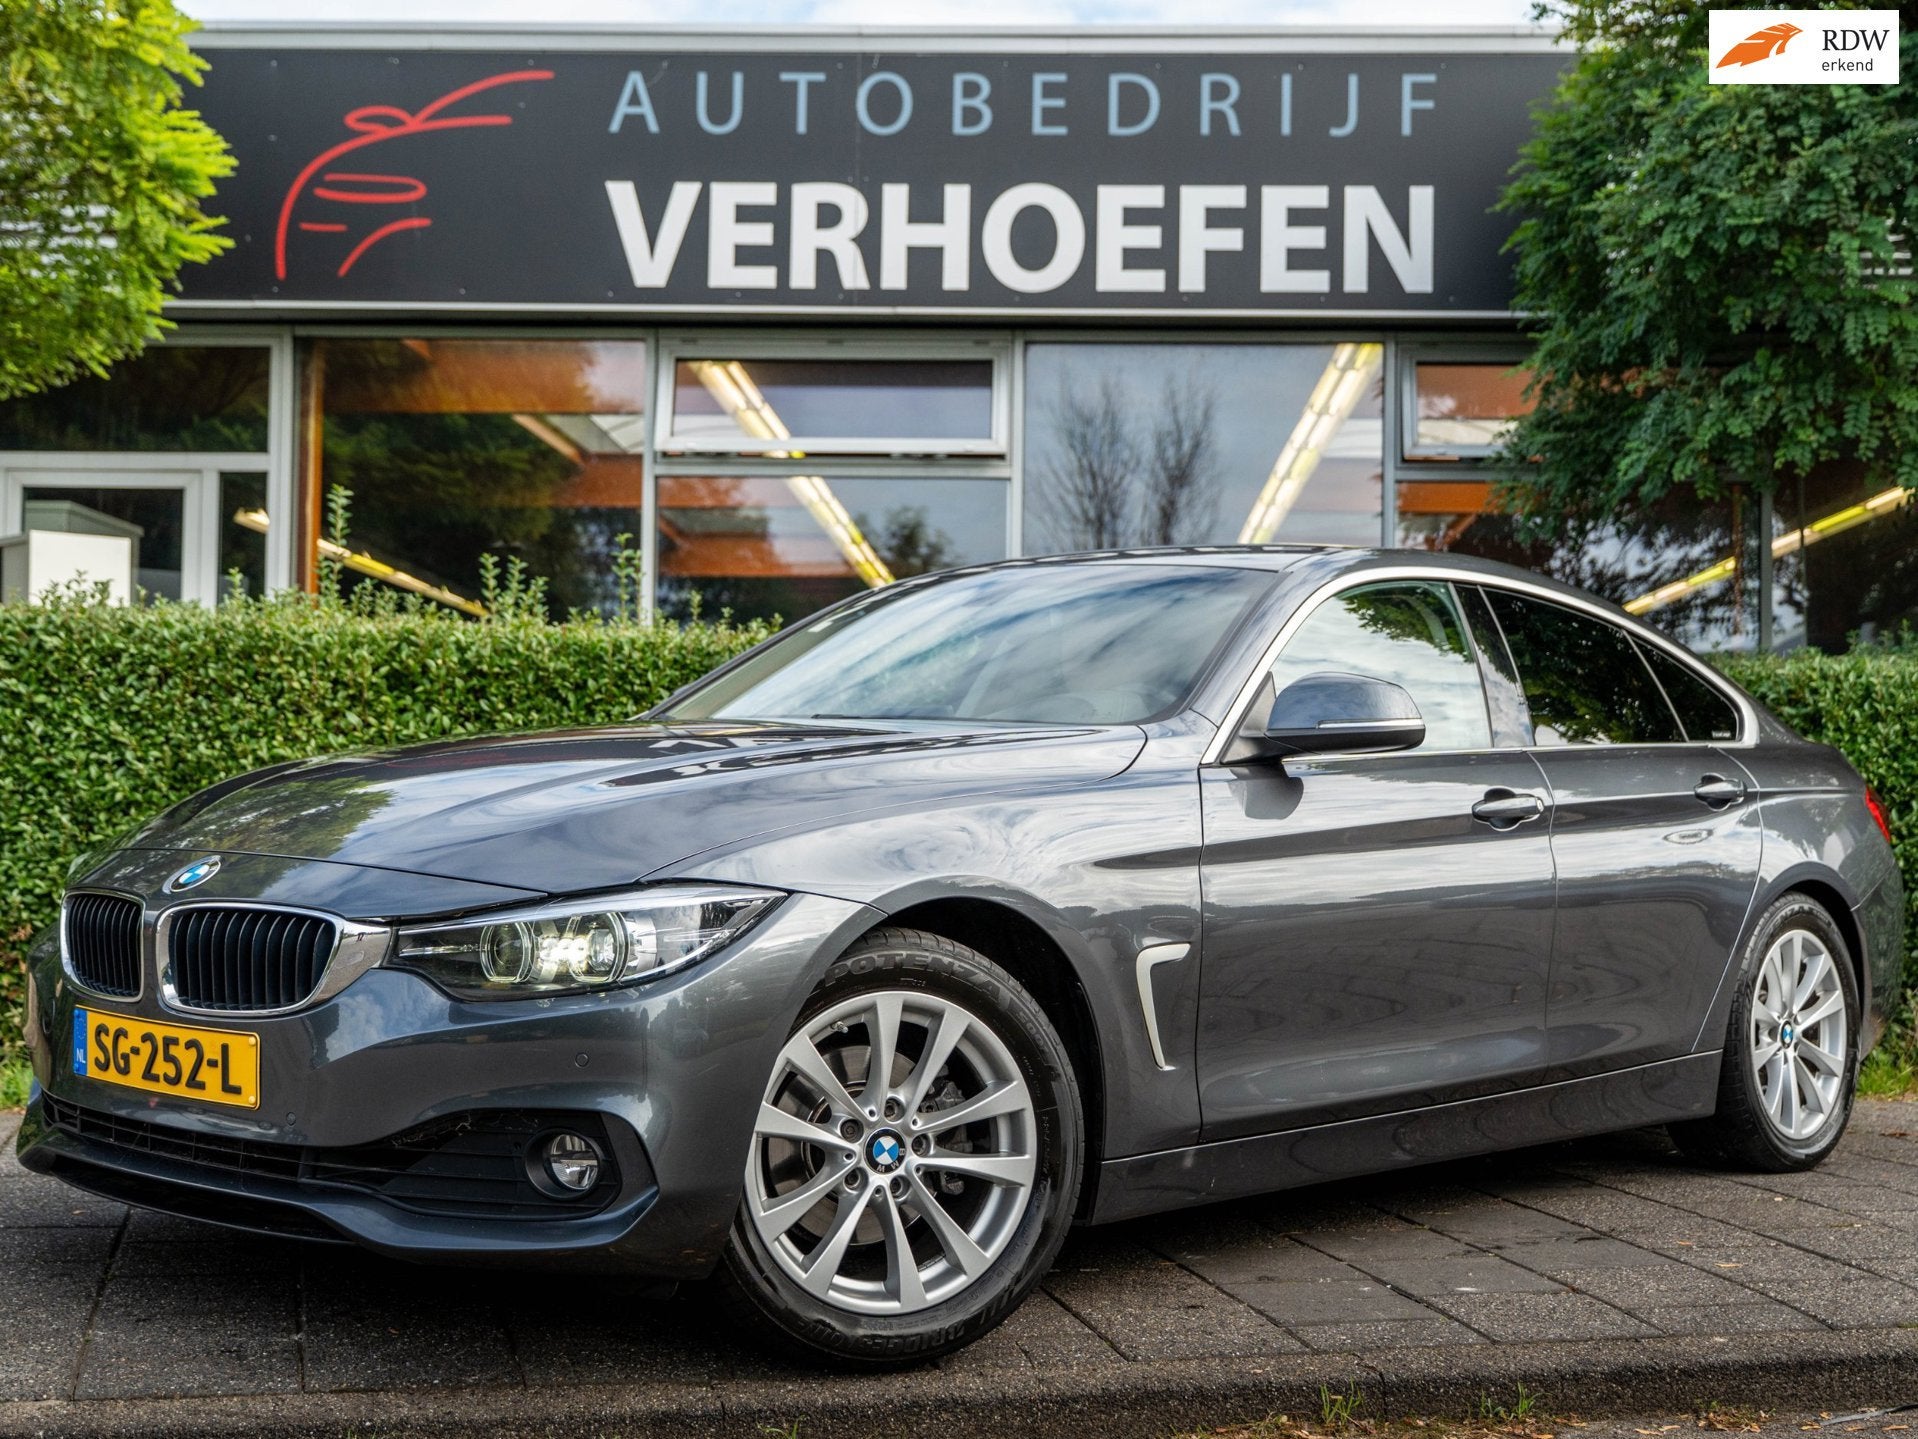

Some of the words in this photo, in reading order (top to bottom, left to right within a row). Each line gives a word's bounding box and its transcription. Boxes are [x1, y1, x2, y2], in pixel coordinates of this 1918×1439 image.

[608, 71, 1437, 137] AUTOBEDRIJF
[604, 180, 1435, 293] VERHOEFEN
[824, 952, 1001, 1004] POTENZA
[76, 1048, 86, 1064] NL
[94, 1023, 243, 1095] SG-252-L
